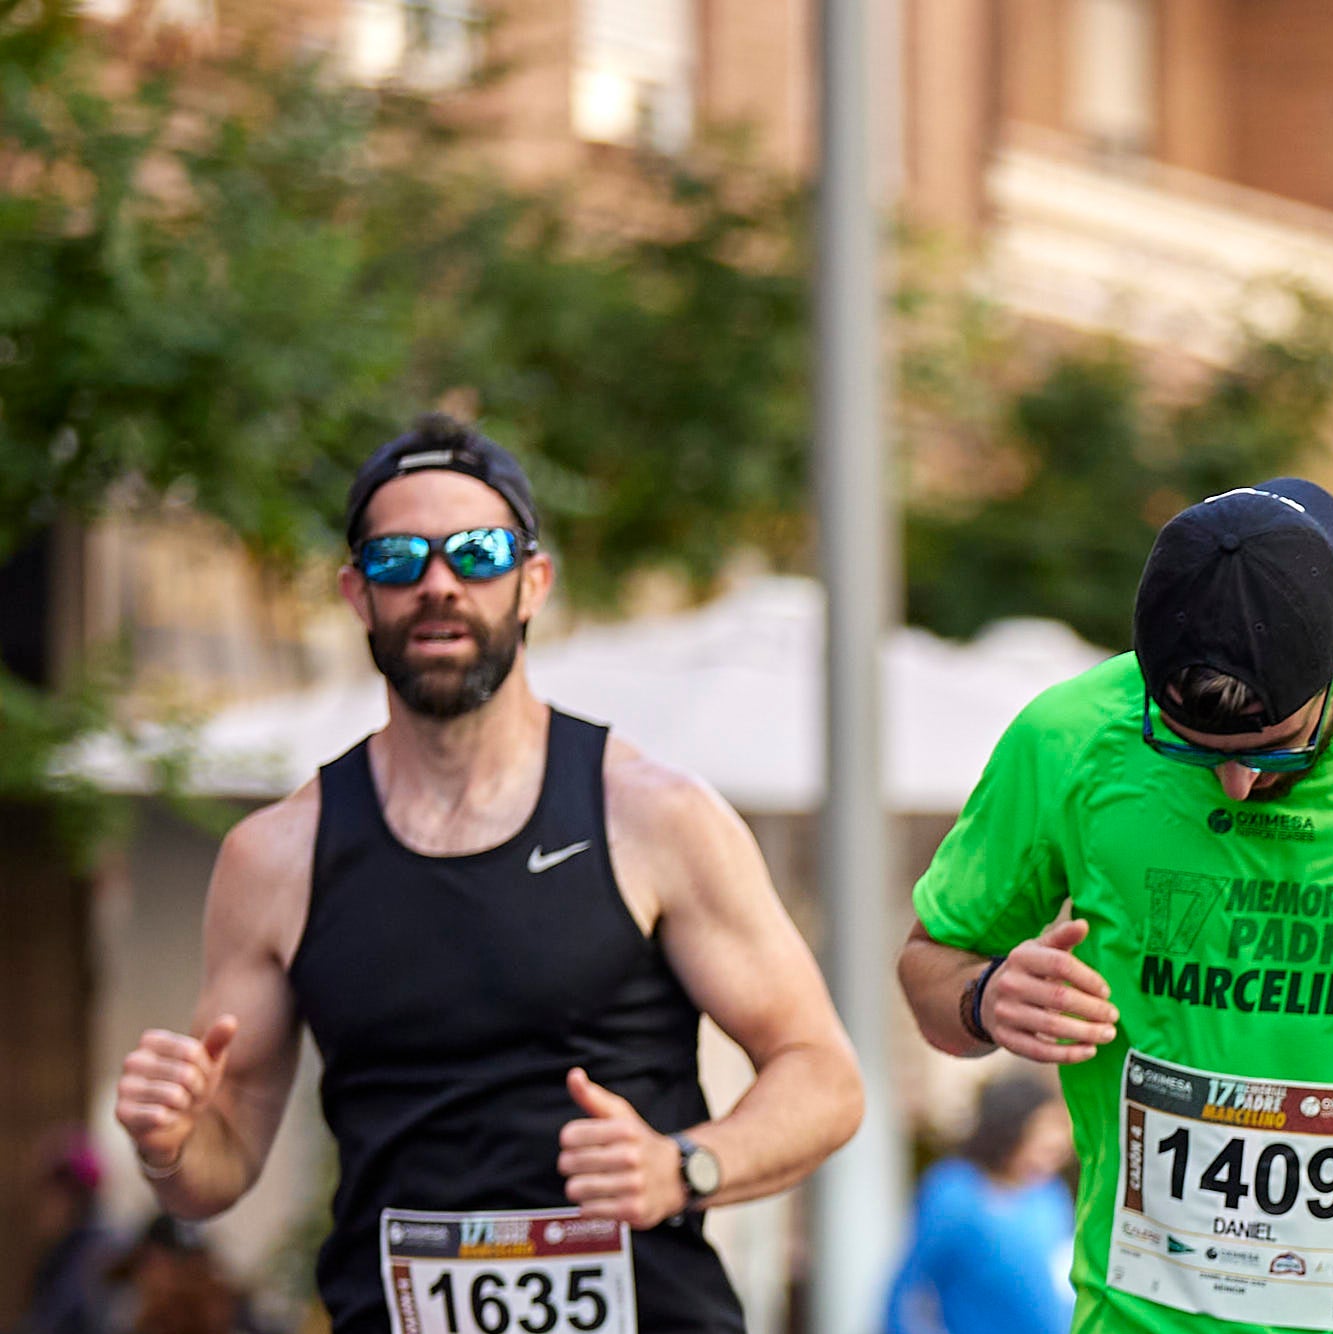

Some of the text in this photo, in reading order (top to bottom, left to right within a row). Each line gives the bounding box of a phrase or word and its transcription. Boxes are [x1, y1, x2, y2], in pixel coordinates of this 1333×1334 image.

[1236, 811, 1315, 829] OXIMESA
[1208, 1080, 1236, 1106] 17
[1234, 1095, 1284, 1112] PADRE
[1202, 1105, 1287, 1128] MARCELINO
[1213, 1217, 1277, 1242] DANIEL
